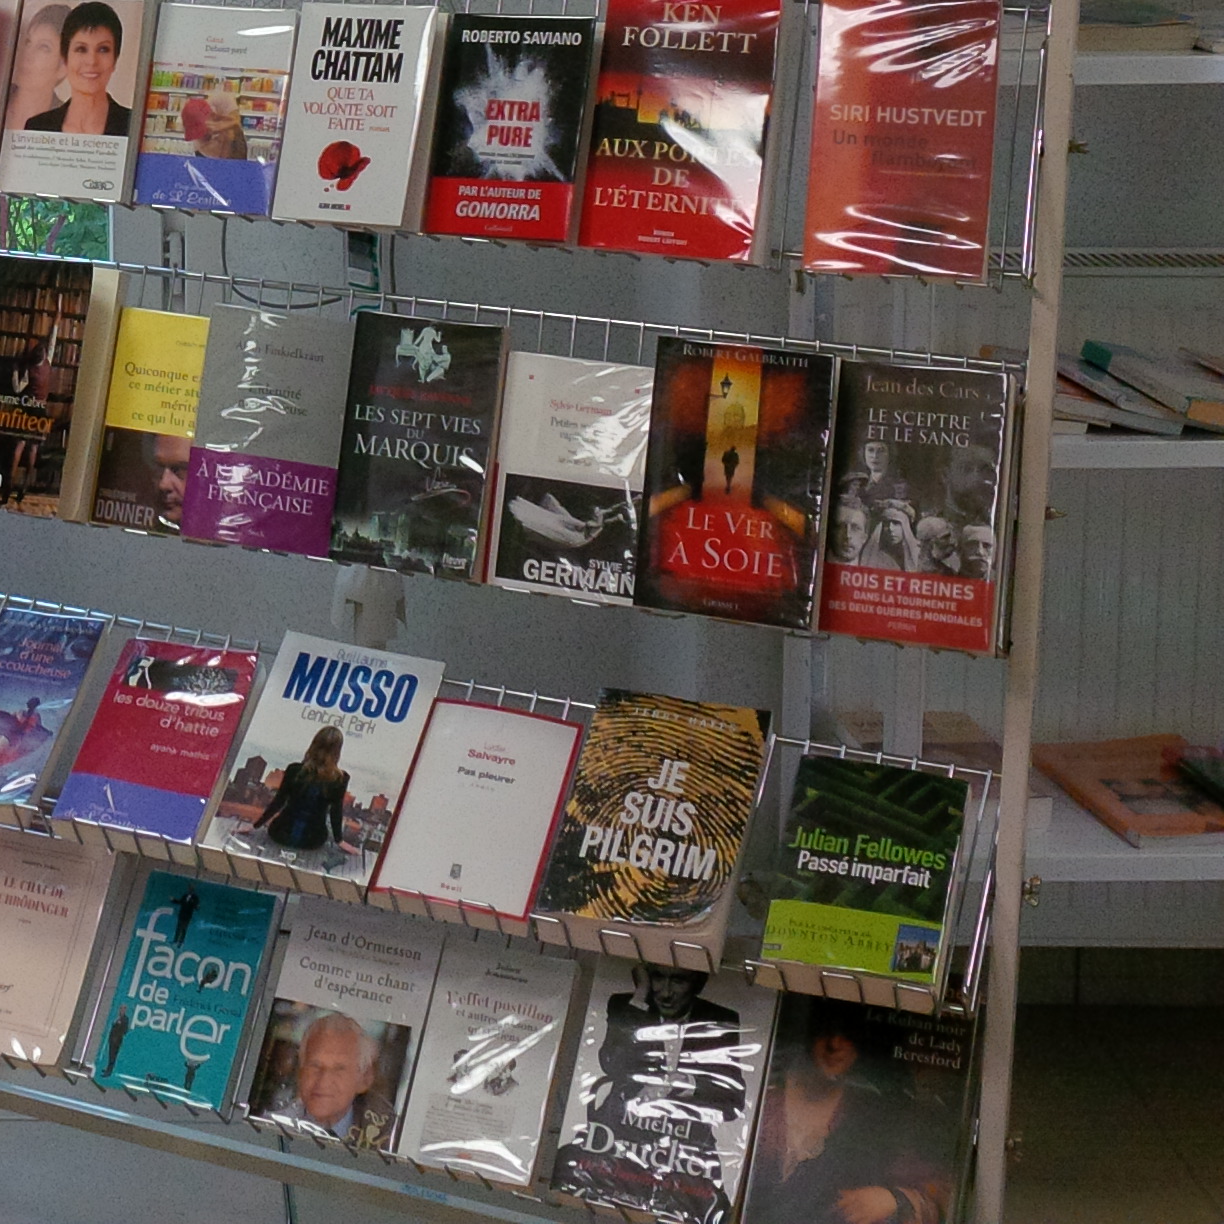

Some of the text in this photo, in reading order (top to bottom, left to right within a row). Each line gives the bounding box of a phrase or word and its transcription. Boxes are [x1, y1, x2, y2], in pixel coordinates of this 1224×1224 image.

[663, 3, 721, 26] KEN
[320, 17, 404, 50] MAXIME
[462, 30, 582, 47] ROBERTO SAVIANO
[622, 26, 757, 54] FOLLETT
[311, 50, 404, 84] CHATTAM
[327, 87, 374, 102] QUE TA
[366, 104, 397, 118] SOIT
[485, 98, 541, 123] EXTRA
[830, 104, 986, 127] SIRI HUSTVEDT
[327, 116, 364, 131] FAITE
[486, 125, 534, 148] PURE
[596, 138, 649, 158] AUX
[652, 167, 690, 188] DE
[458, 185, 541, 200] PAR L'AUTEUR DE
[455, 201, 540, 221] GOMORRA
[354, 404, 482, 435] LES SEPT VIES
[868, 408, 971, 430] LE SCEPTRE
[406, 428, 424, 440] DU
[867, 425, 970, 448] ET LE SANG
[96, 498, 154, 527] DONNER
[687, 507, 773, 540] LE VER
[701, 537, 783, 578] SOIE
[840, 572, 974, 600] ROIS ET REINES
[854, 589, 957, 611] DANS LA TOURMENTE
[282, 651, 419, 724] MUSSO
[113, 691, 179, 714] les douze
[349, 717, 376, 735] Park
[467, 748, 516, 766] Salvayre
[647, 758, 690, 794] JE
[620, 790, 698, 836] SUIS
[578, 826, 717, 880] PILGRIM
[788, 826, 946, 870] Julian Fellowes
[797, 850, 931, 888] Passé imparfait
[127, 907, 252, 998] façon
[138, 979, 169, 1005] de
